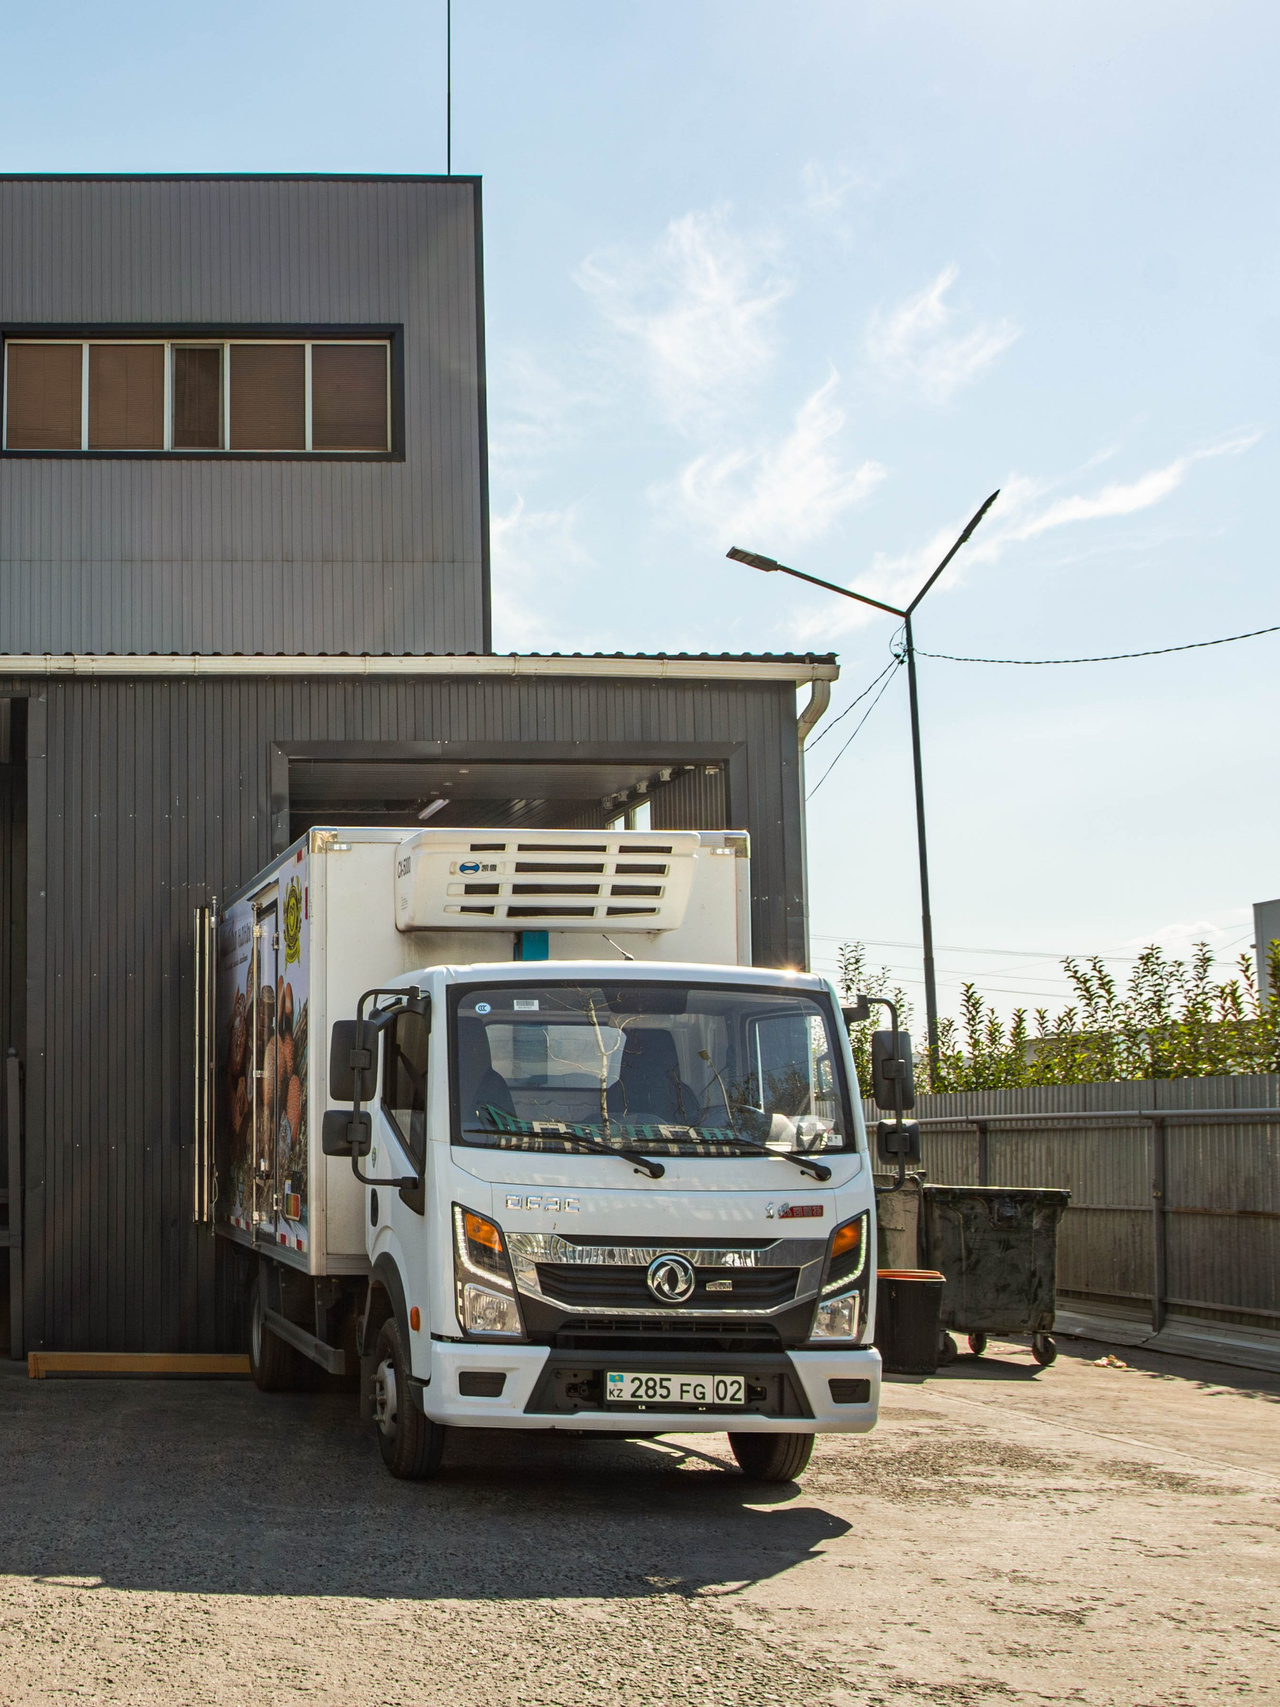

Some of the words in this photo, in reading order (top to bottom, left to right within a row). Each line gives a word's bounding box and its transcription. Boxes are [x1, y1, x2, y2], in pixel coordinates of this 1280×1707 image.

[505, 1194, 579, 1213] DFAC
[609, 1388, 623, 1398] KZ
[630, 1377, 672, 1399] 285
[680, 1383, 706, 1401] FG
[715, 1379, 742, 1402] 02
